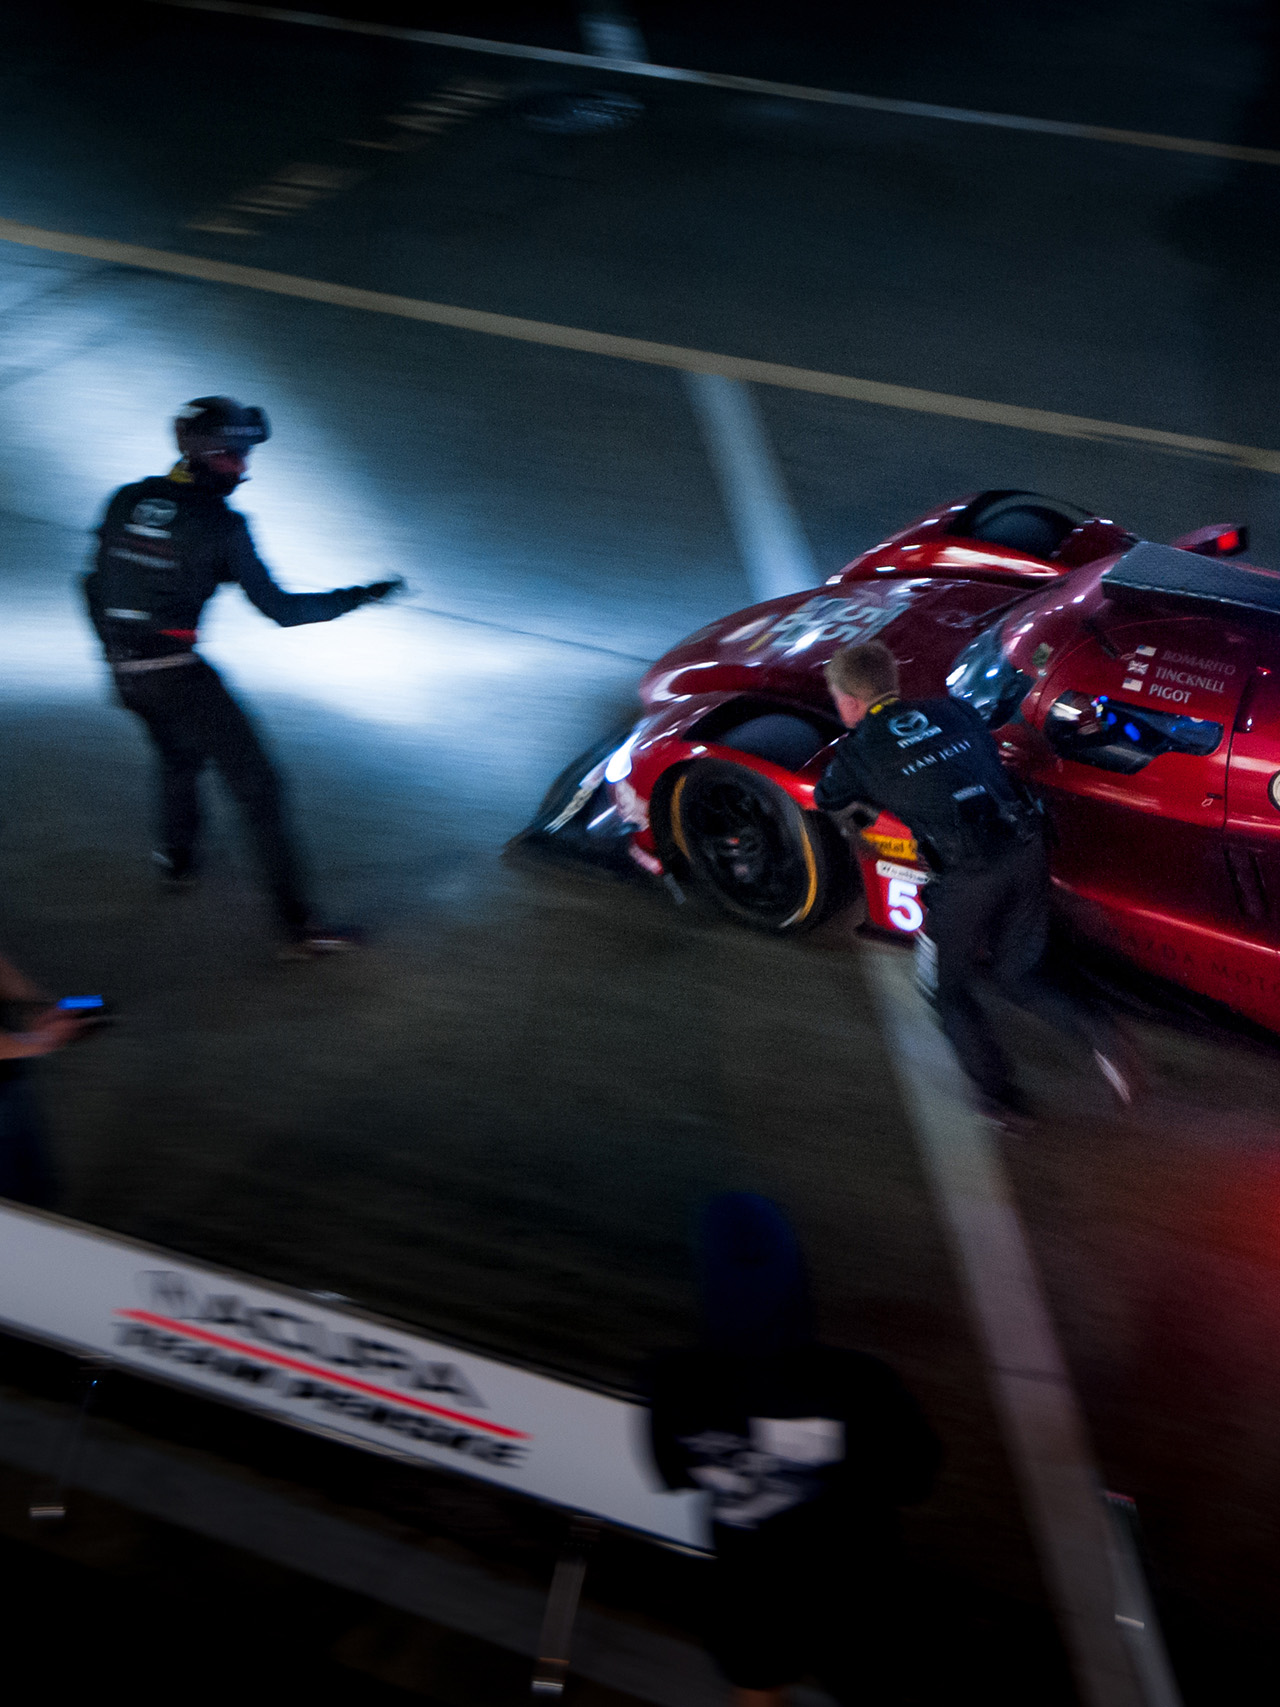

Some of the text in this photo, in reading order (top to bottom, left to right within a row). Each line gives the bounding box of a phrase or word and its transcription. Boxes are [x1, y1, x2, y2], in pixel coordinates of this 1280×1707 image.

[1161, 650, 1236, 676] BOMARITO
[1155, 666, 1225, 694] TINCKNELL
[1148, 683, 1192, 704] PIGOT
